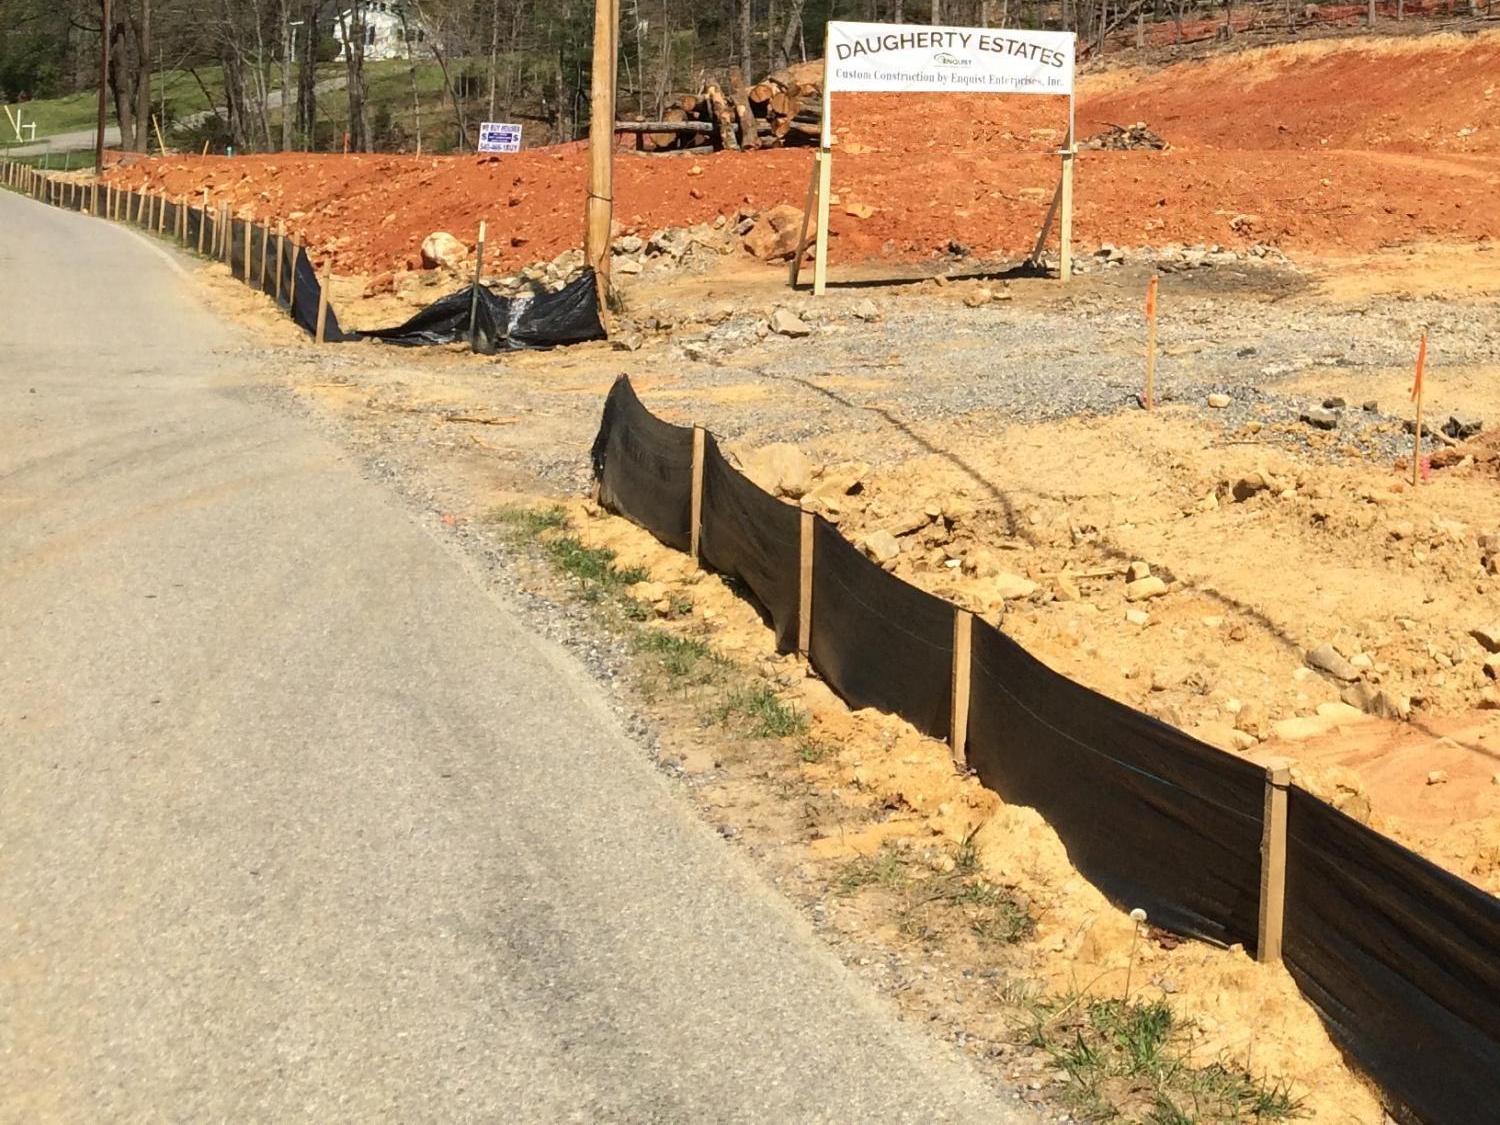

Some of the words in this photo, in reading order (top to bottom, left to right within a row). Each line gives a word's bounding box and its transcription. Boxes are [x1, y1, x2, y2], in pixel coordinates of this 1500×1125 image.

[836, 31, 972, 60] DAUGHERTY
[979, 35, 1065, 68] ESTATES
[835, 68, 872, 80] Custom
[874, 70, 935, 83] Construction
[937, 72, 948, 84] by
[951, 73, 986, 86] Enquist
[989, 74, 1045, 88] Enterprises,
[1047, 75, 1064, 87] Inc.
